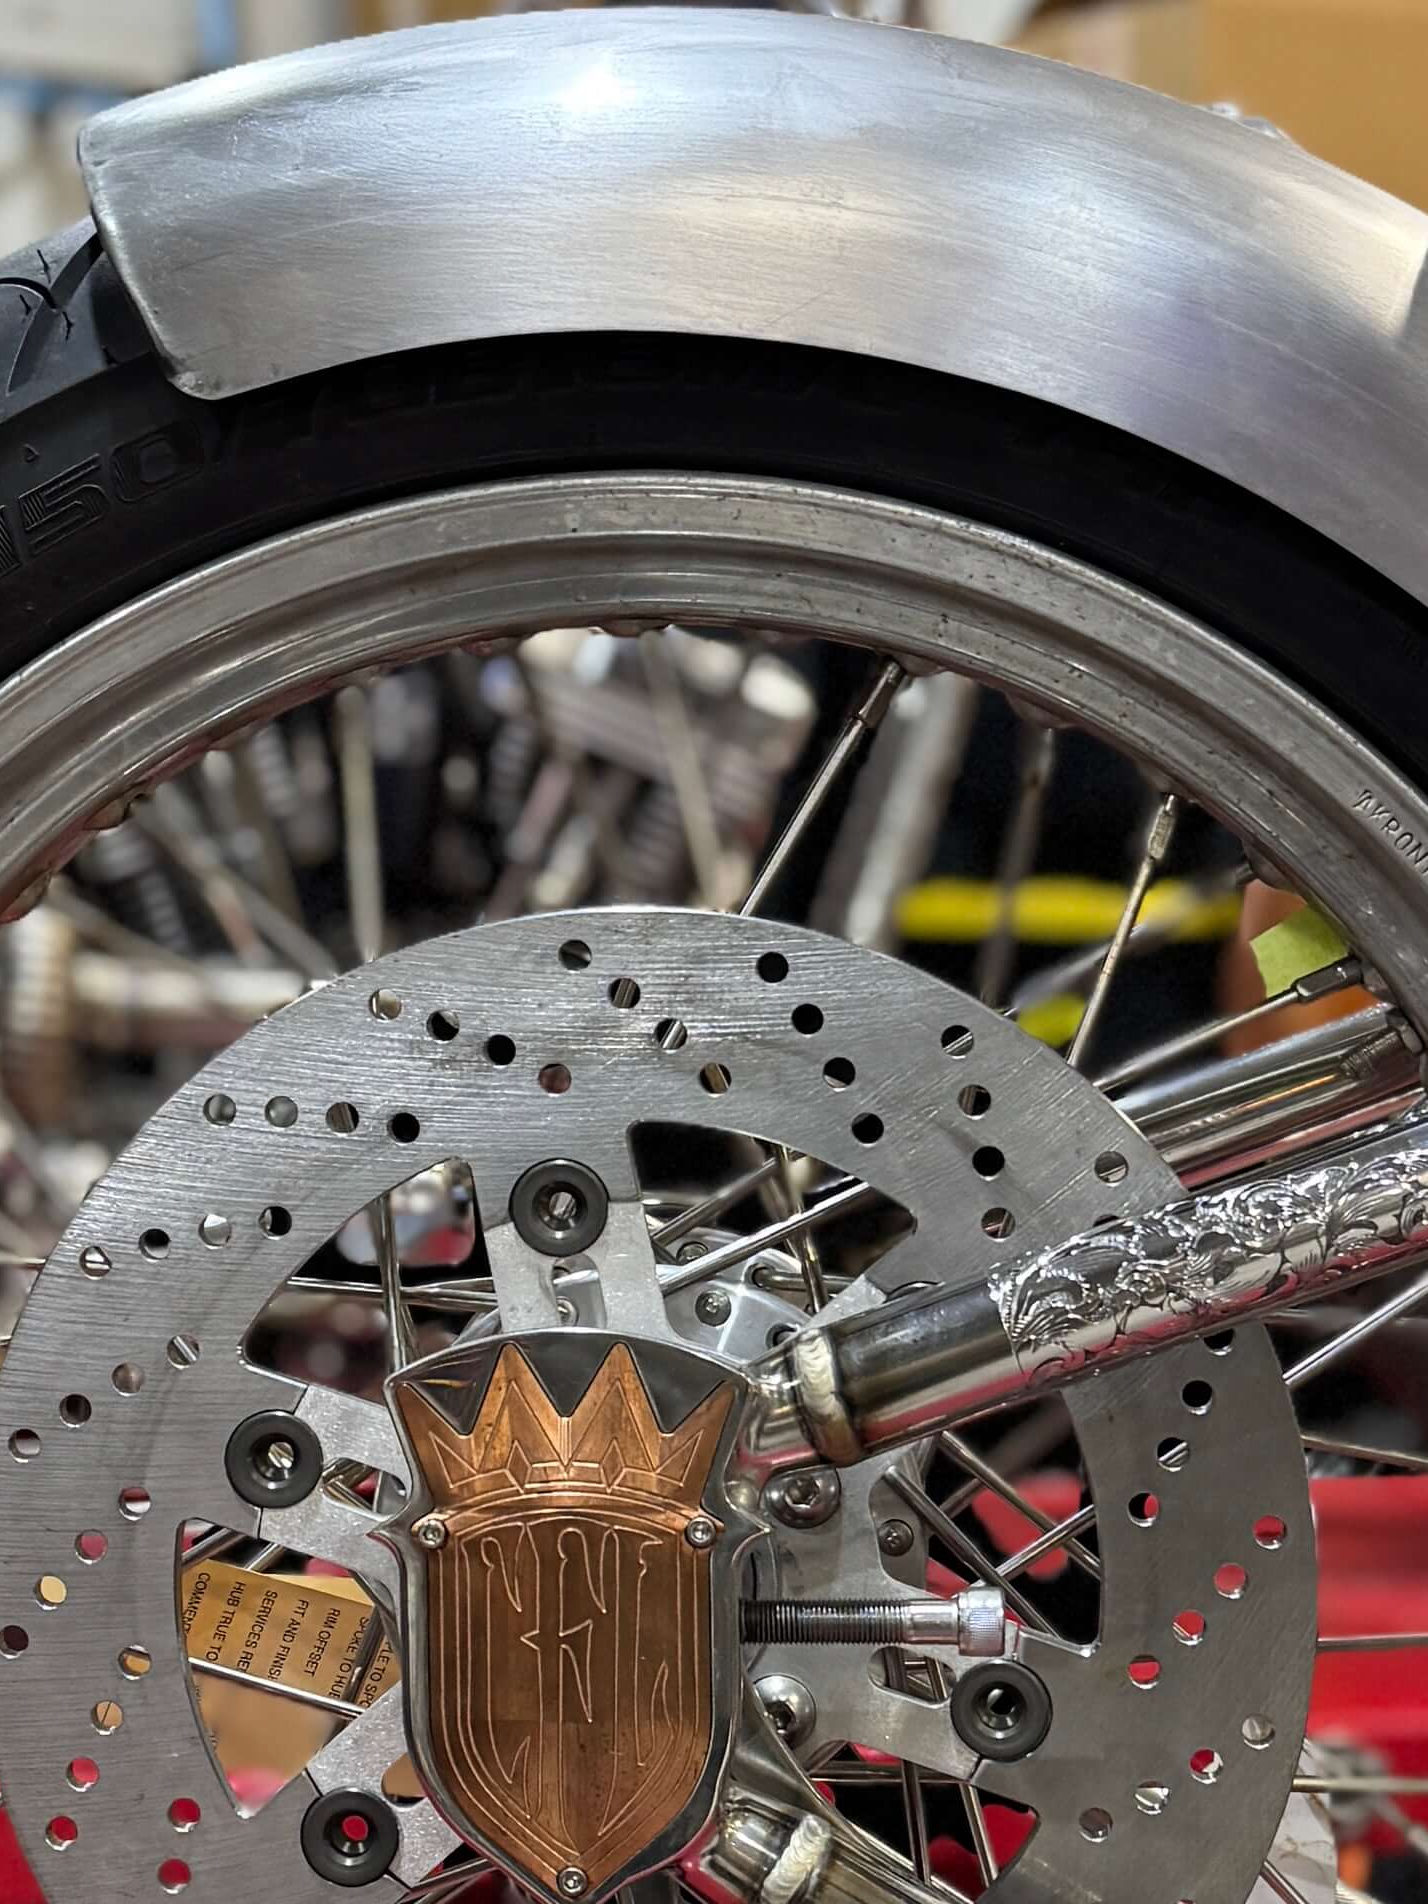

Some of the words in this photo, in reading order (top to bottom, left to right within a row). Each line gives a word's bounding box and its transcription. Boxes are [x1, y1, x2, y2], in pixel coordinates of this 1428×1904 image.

[225, 1581, 246, 1607] HUB
[243, 1589, 278, 1649] SERVICES
[292, 1598, 309, 1617] FIT
[321, 1607, 341, 1631] RIM
[212, 1608, 235, 1642] TRUE
[281, 1617, 301, 1644] AND
[204, 1643, 222, 1662] TO
[301, 1629, 330, 1678] OFFSET
[368, 1664, 385, 1683] TO
